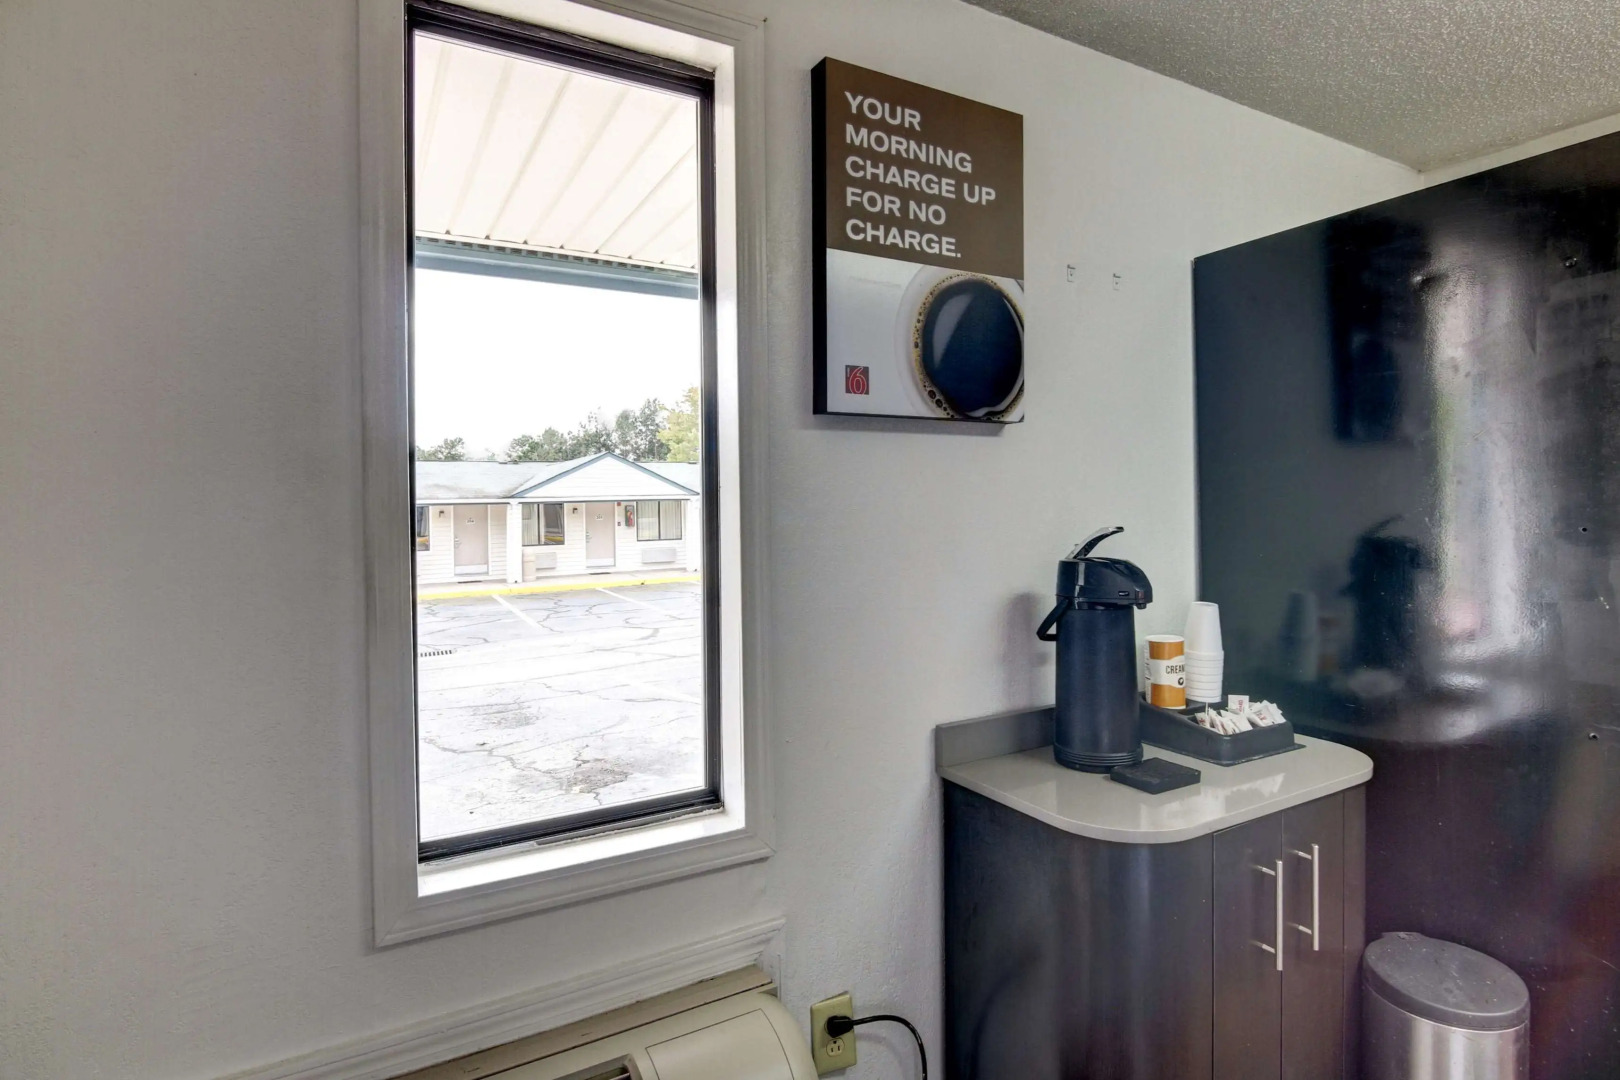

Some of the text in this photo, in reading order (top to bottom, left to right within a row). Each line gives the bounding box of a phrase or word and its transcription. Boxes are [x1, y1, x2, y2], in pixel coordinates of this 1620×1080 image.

[844, 91, 921, 131] YOUR
[845, 123, 972, 173] MORNING
[845, 156, 996, 206] CHARGE UP
[846, 186, 946, 226] FOR NO
[845, 218, 962, 258] CHARGE.
[848, 366, 867, 396] 6
